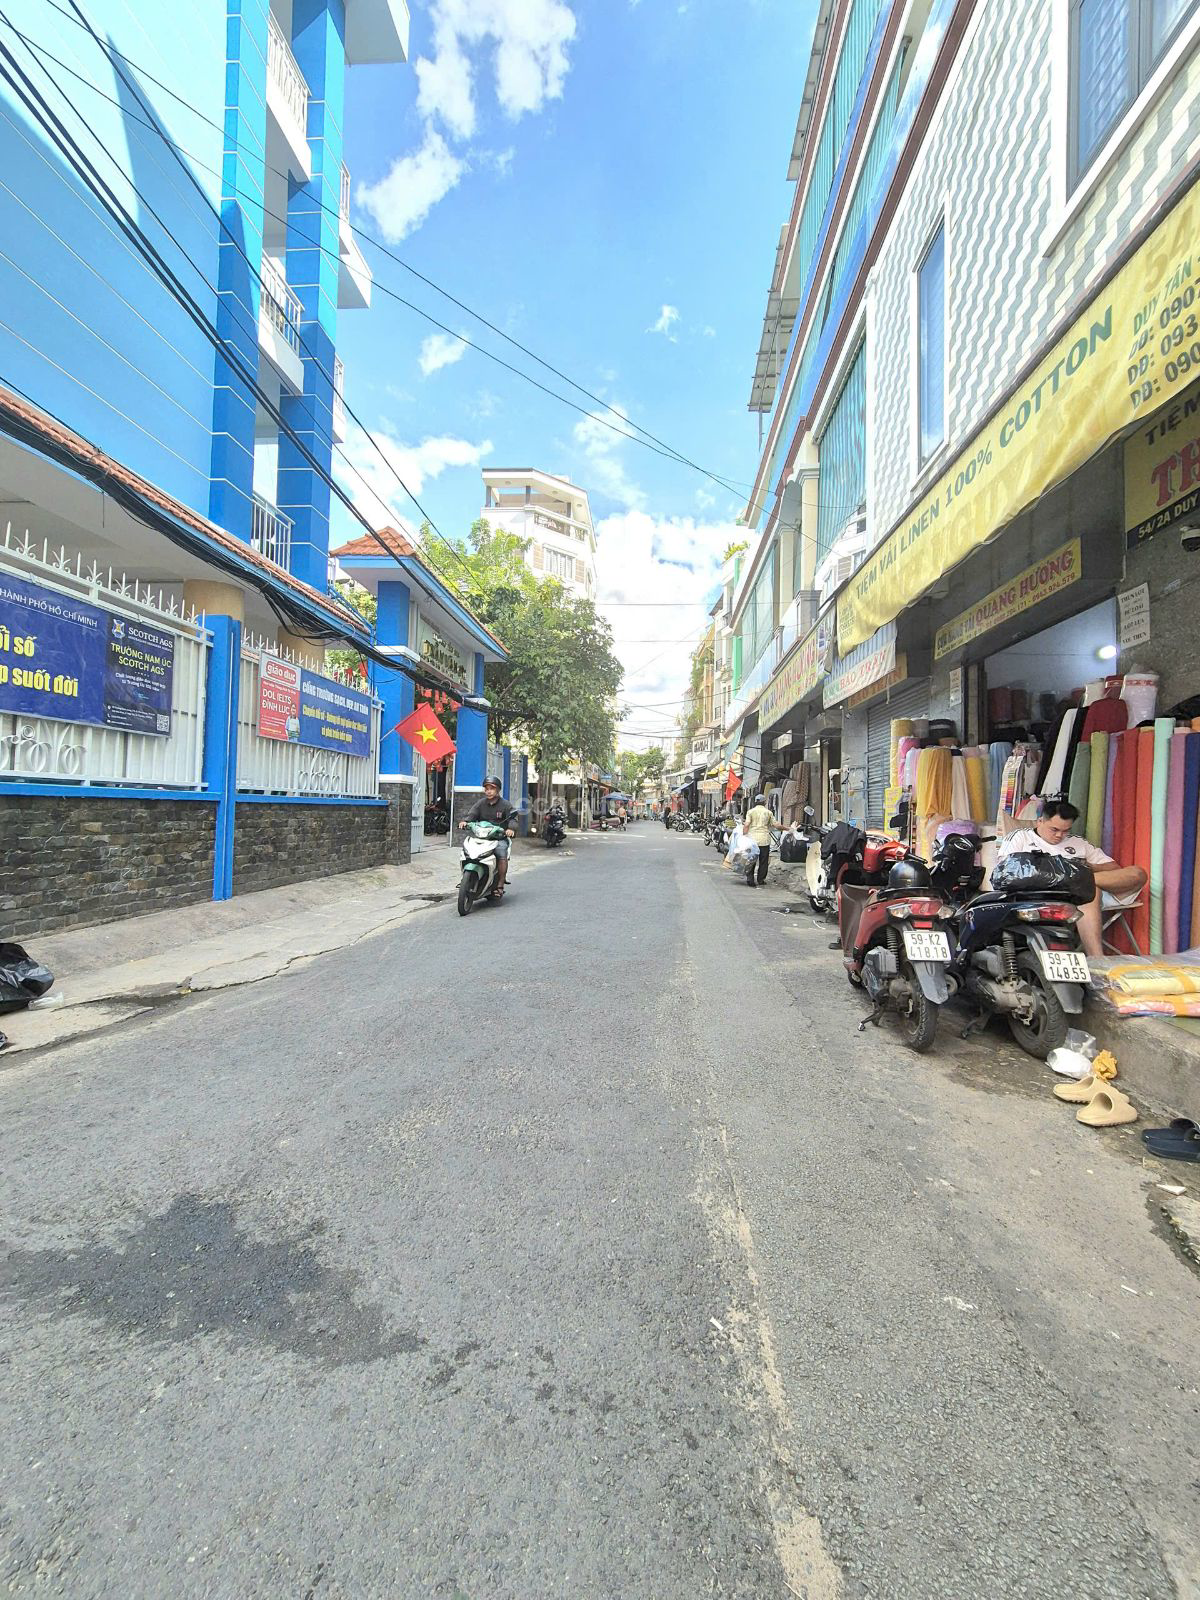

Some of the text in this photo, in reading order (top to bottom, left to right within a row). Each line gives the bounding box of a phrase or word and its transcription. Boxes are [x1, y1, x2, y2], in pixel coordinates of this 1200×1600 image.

[1133, 291, 1161, 336] DUY
[1160, 277, 1200, 330] 090
[1160, 313, 1199, 356] 093
[900, 498, 940, 554] LINEN
[945, 440, 993, 508] 100%
[1000, 304, 1113, 449] COTTON
[1137, 492, 1200, 540] 54/2A DUY
[975, 586, 1016, 623] QUANG
[1019, 547, 1075, 598] HƯƠNG
[28, 597, 48, 611] PHỐ
[49, 604, 62, 616] HỒ
[62, 609, 76, 621] CHÍ
[77, 613, 98, 628] MINH
[13, 634, 37, 658] số
[128, 626, 159, 644] SCOTCH
[159, 637, 173, 649] AGS
[118, 655, 165, 676] SCOTCH AGS
[144, 652, 160, 665] NAM
[12, 667, 51, 692] suốt
[53, 674, 79, 698] đời
[267, 662, 296, 682] giáo dục
[262, 688, 276, 700] DOL
[276, 692, 292, 705] IELTS
[910, 932, 942, 946] 59-K2
[909, 946, 949, 959] 418.18
[1047, 952, 1081, 967] 59-TA
[1048, 966, 1088, 980] 148.55
